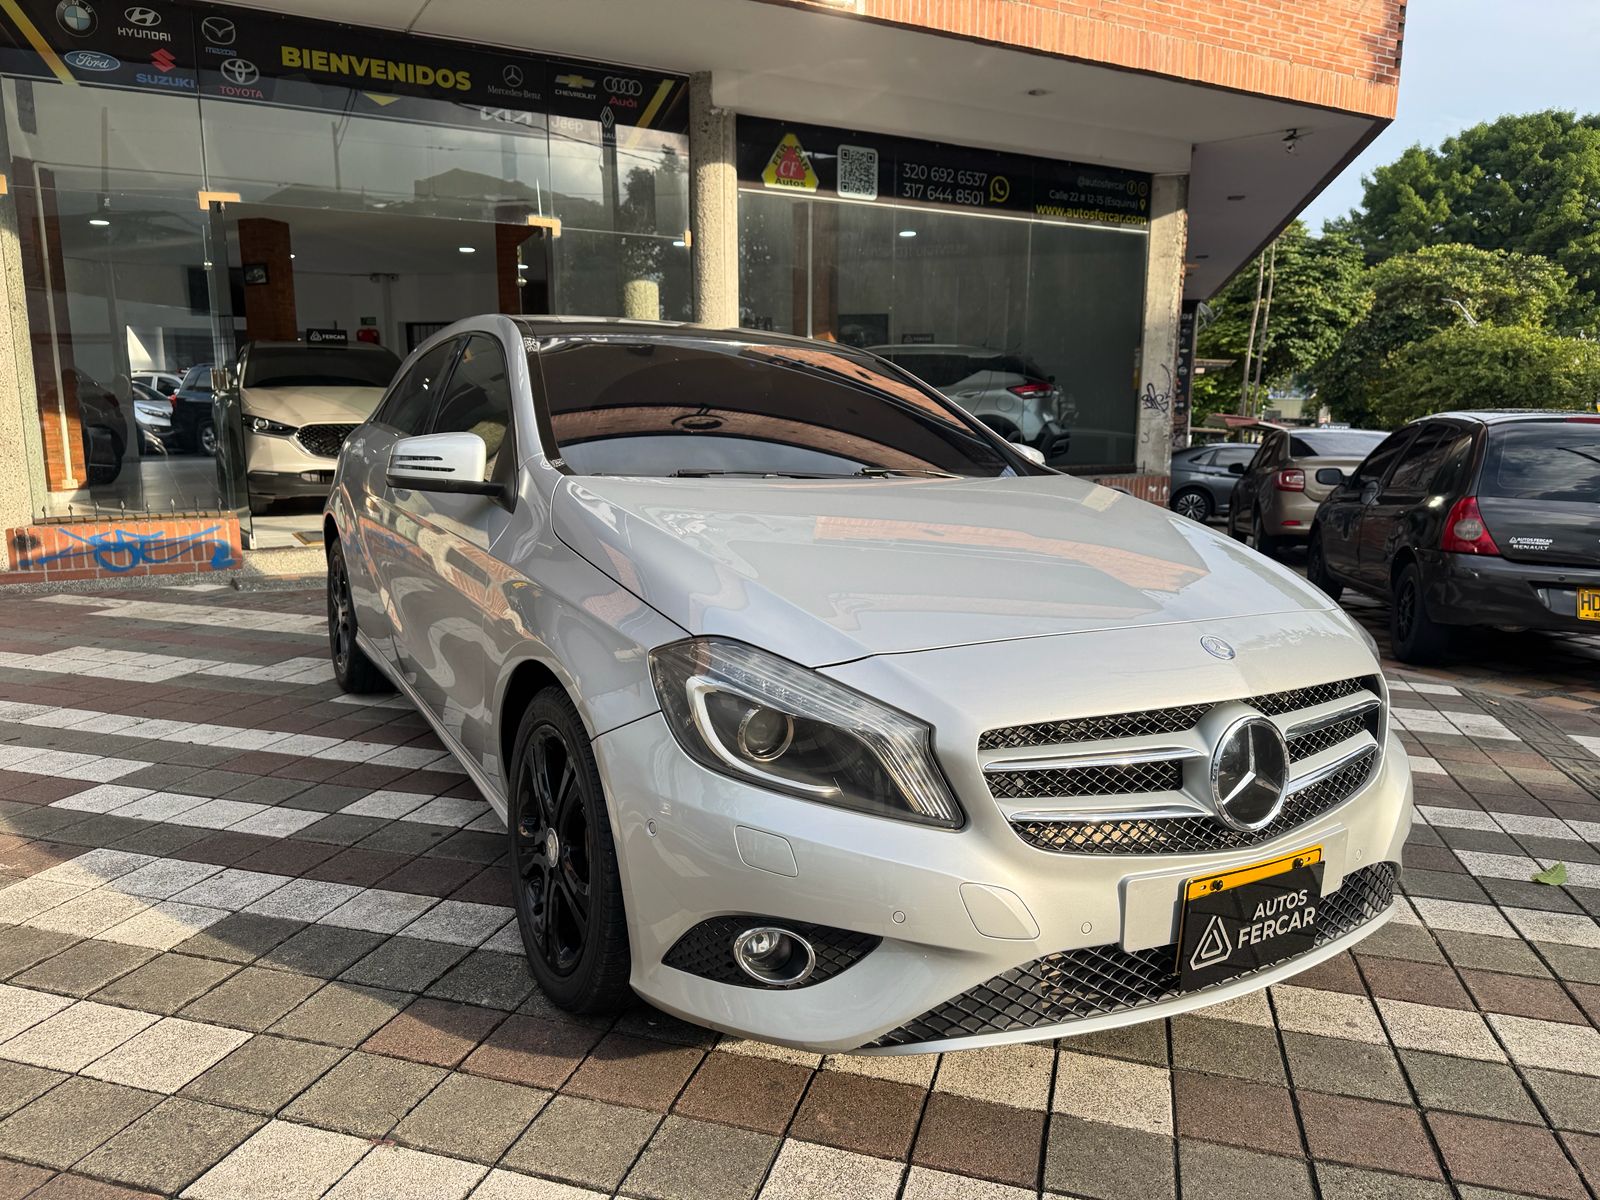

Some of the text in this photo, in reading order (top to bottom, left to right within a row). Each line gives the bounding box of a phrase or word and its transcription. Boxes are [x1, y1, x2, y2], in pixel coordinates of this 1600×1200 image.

[117, 26, 172, 42] HYUNDAI
[76, 52, 110, 70] Ford
[280, 45, 472, 92] BIENVENIDOS
[136, 73, 195, 89] SUZUKI
[220, 86, 264, 99] TOYOTA
[554, 88, 597, 100] CHEVROLET
[608, 95, 638, 108] Audi
[550, 116, 584, 133] Jeep
[773, 144, 788, 166] FER
[775, 178, 807, 188] Autos
[903, 162, 988, 187] 320 692 6537
[903, 182, 984, 205] 317 644 8501
[1049, 189, 1069, 201] Calle
[1069, 192, 1079, 202] 22
[1035, 203, 1147, 225] www.autosfercar.com
[1252, 888, 1308, 921] AUTOS
[1237, 906, 1316, 949] FERCAR
